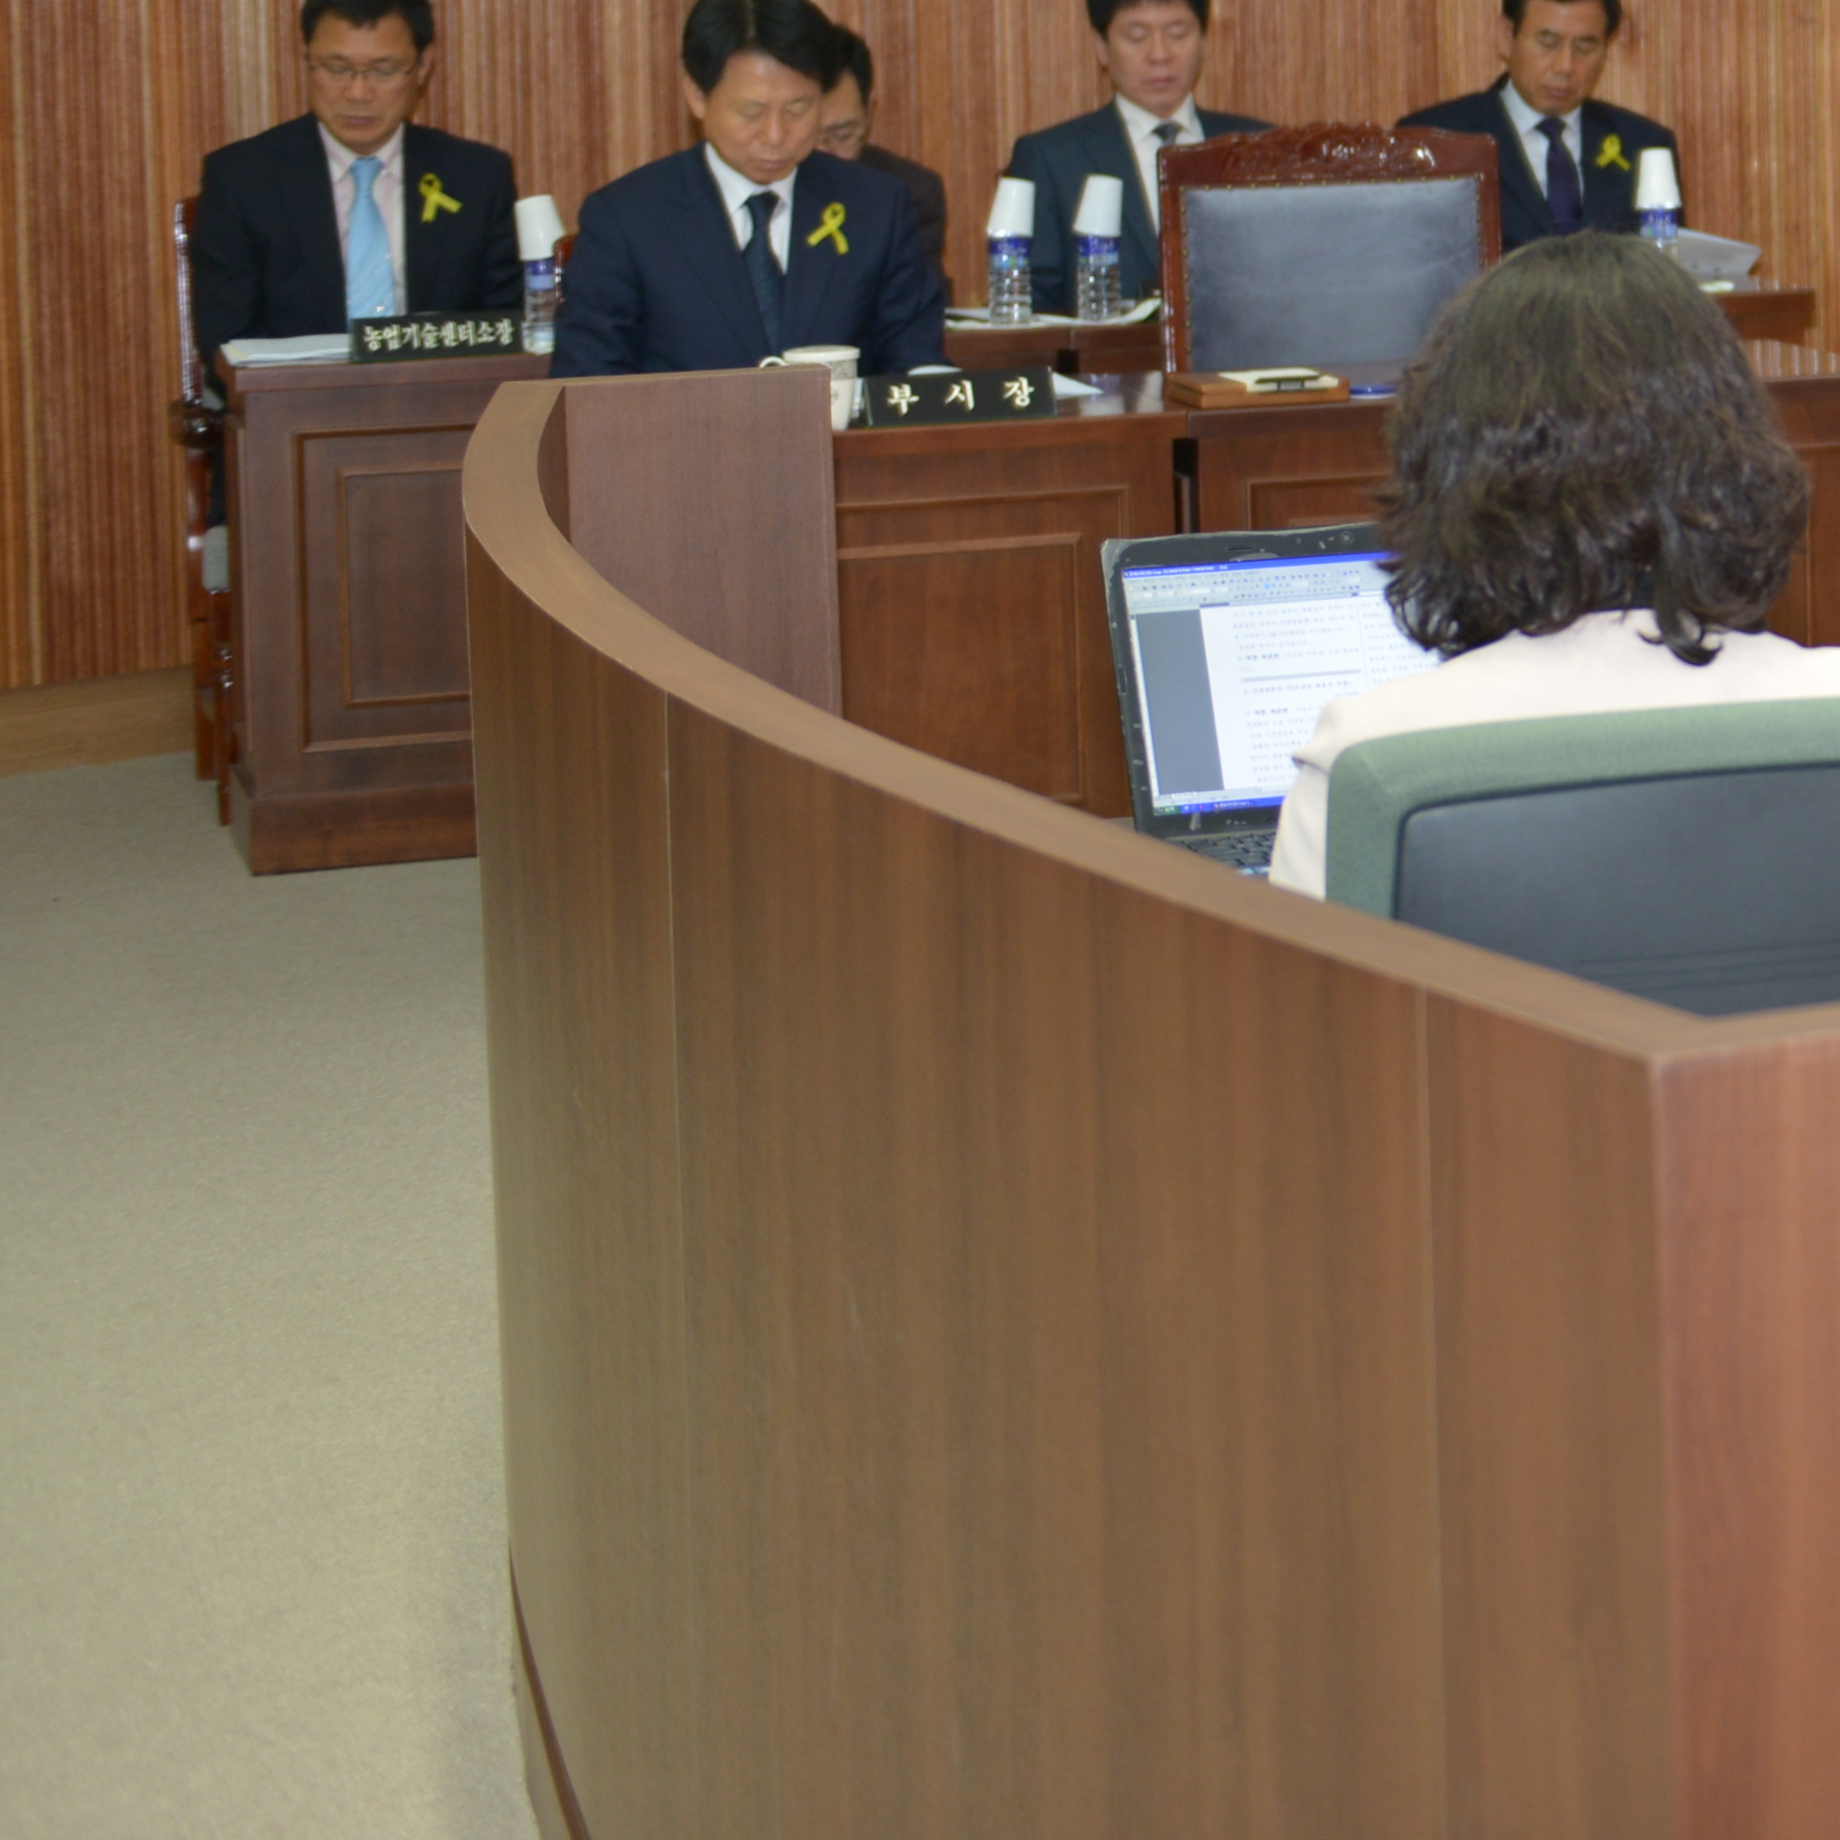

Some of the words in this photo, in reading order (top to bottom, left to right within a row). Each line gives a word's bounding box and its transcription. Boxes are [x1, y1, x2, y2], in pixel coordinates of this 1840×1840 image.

[363, 317, 515, 352] 농업기술센터소장
[886, 382, 920, 417] 부
[943, 378, 975, 411] 시
[1003, 376, 1035, 408] 장
